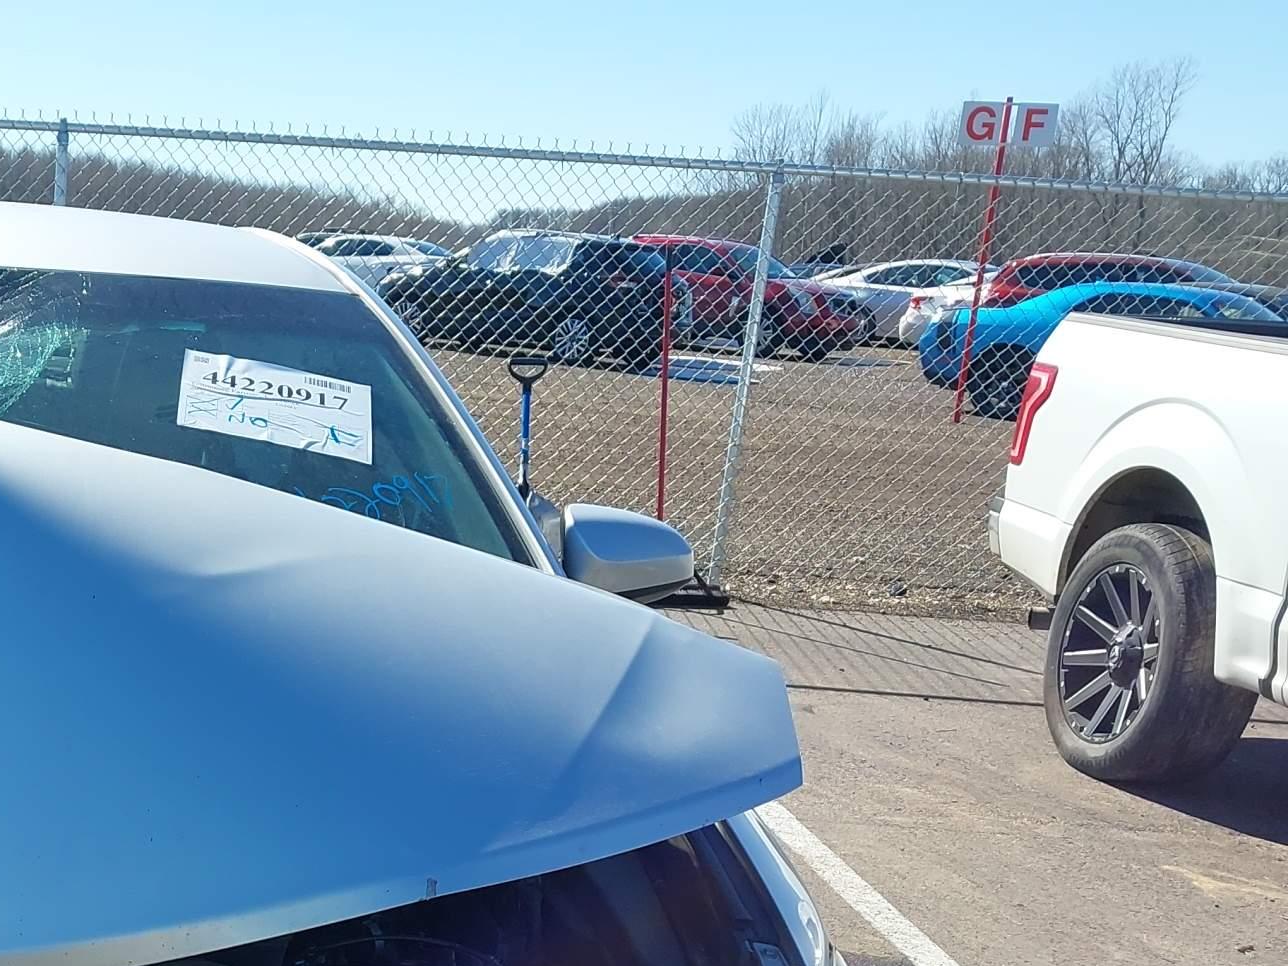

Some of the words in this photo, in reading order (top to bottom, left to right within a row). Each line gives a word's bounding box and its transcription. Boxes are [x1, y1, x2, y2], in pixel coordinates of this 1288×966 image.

[966, 105, 997, 141] G
[1021, 108, 1049, 141] F
[202, 371, 349, 410] 44220917
